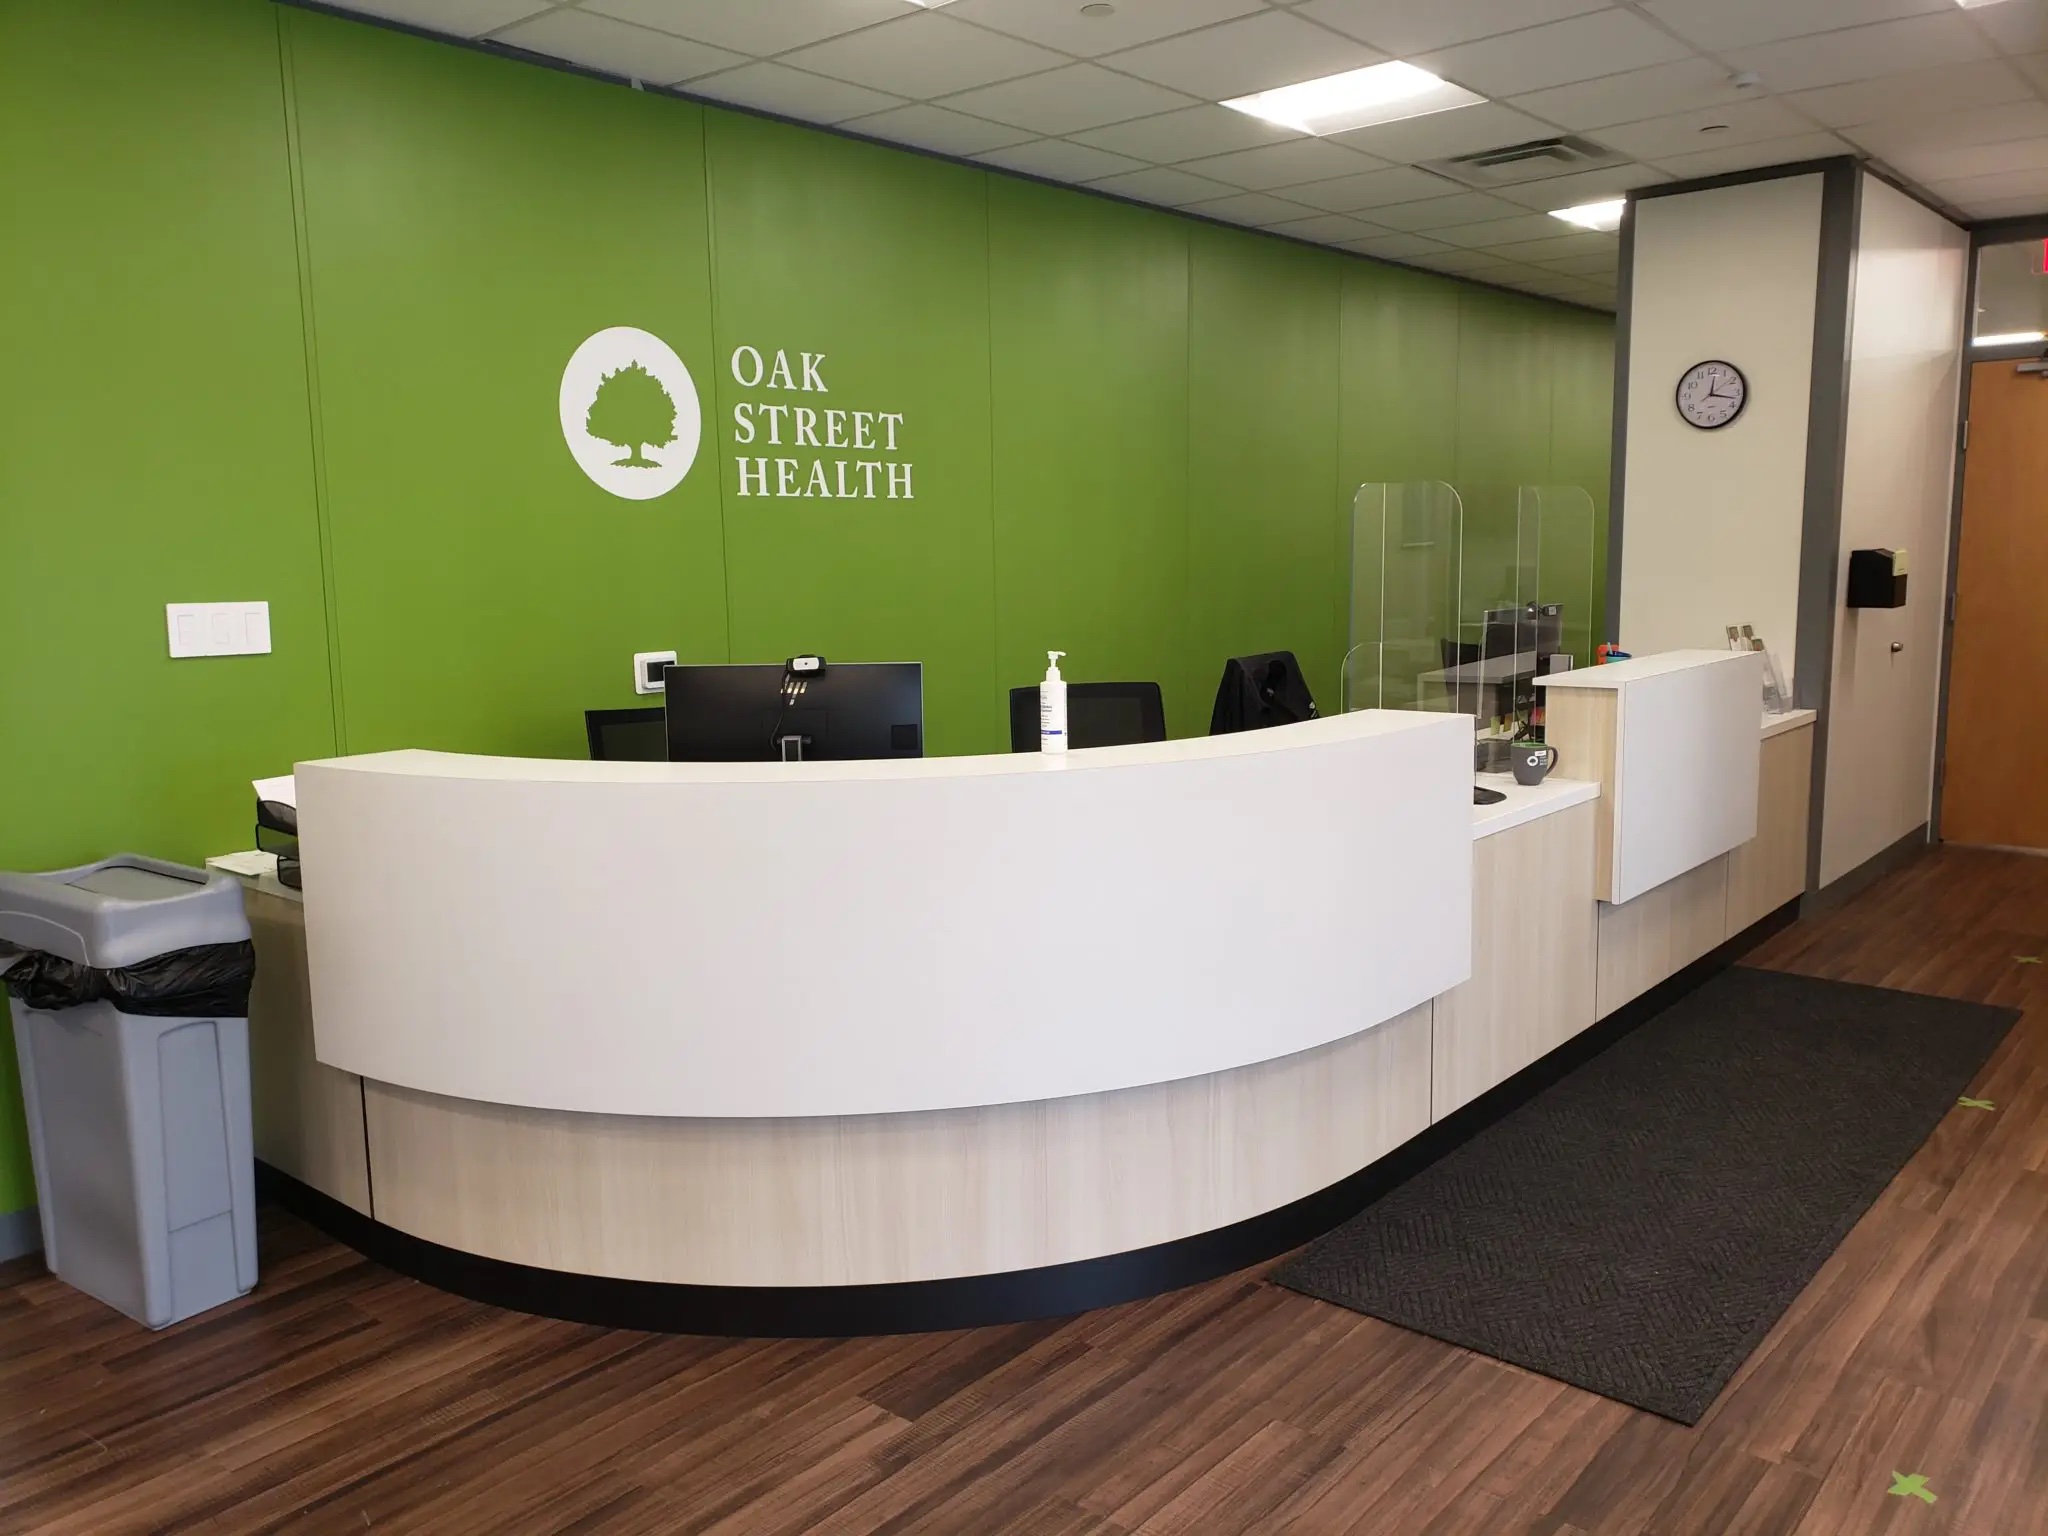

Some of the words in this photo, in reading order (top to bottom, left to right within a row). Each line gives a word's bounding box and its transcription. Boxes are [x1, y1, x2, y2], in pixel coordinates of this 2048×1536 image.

[731, 345, 828, 392] OAK
[1708, 367, 1717, 375] 12
[1697, 371, 1704, 379] 11
[1688, 381, 1698, 389] 10
[1688, 404, 1695, 412] 8
[1728, 401, 1736, 409] 4
[1696, 411, 1703, 420] 7
[1707, 413, 1715, 421] 6
[733, 402, 904, 450] STREET
[735, 456, 914, 499] HEALTH
